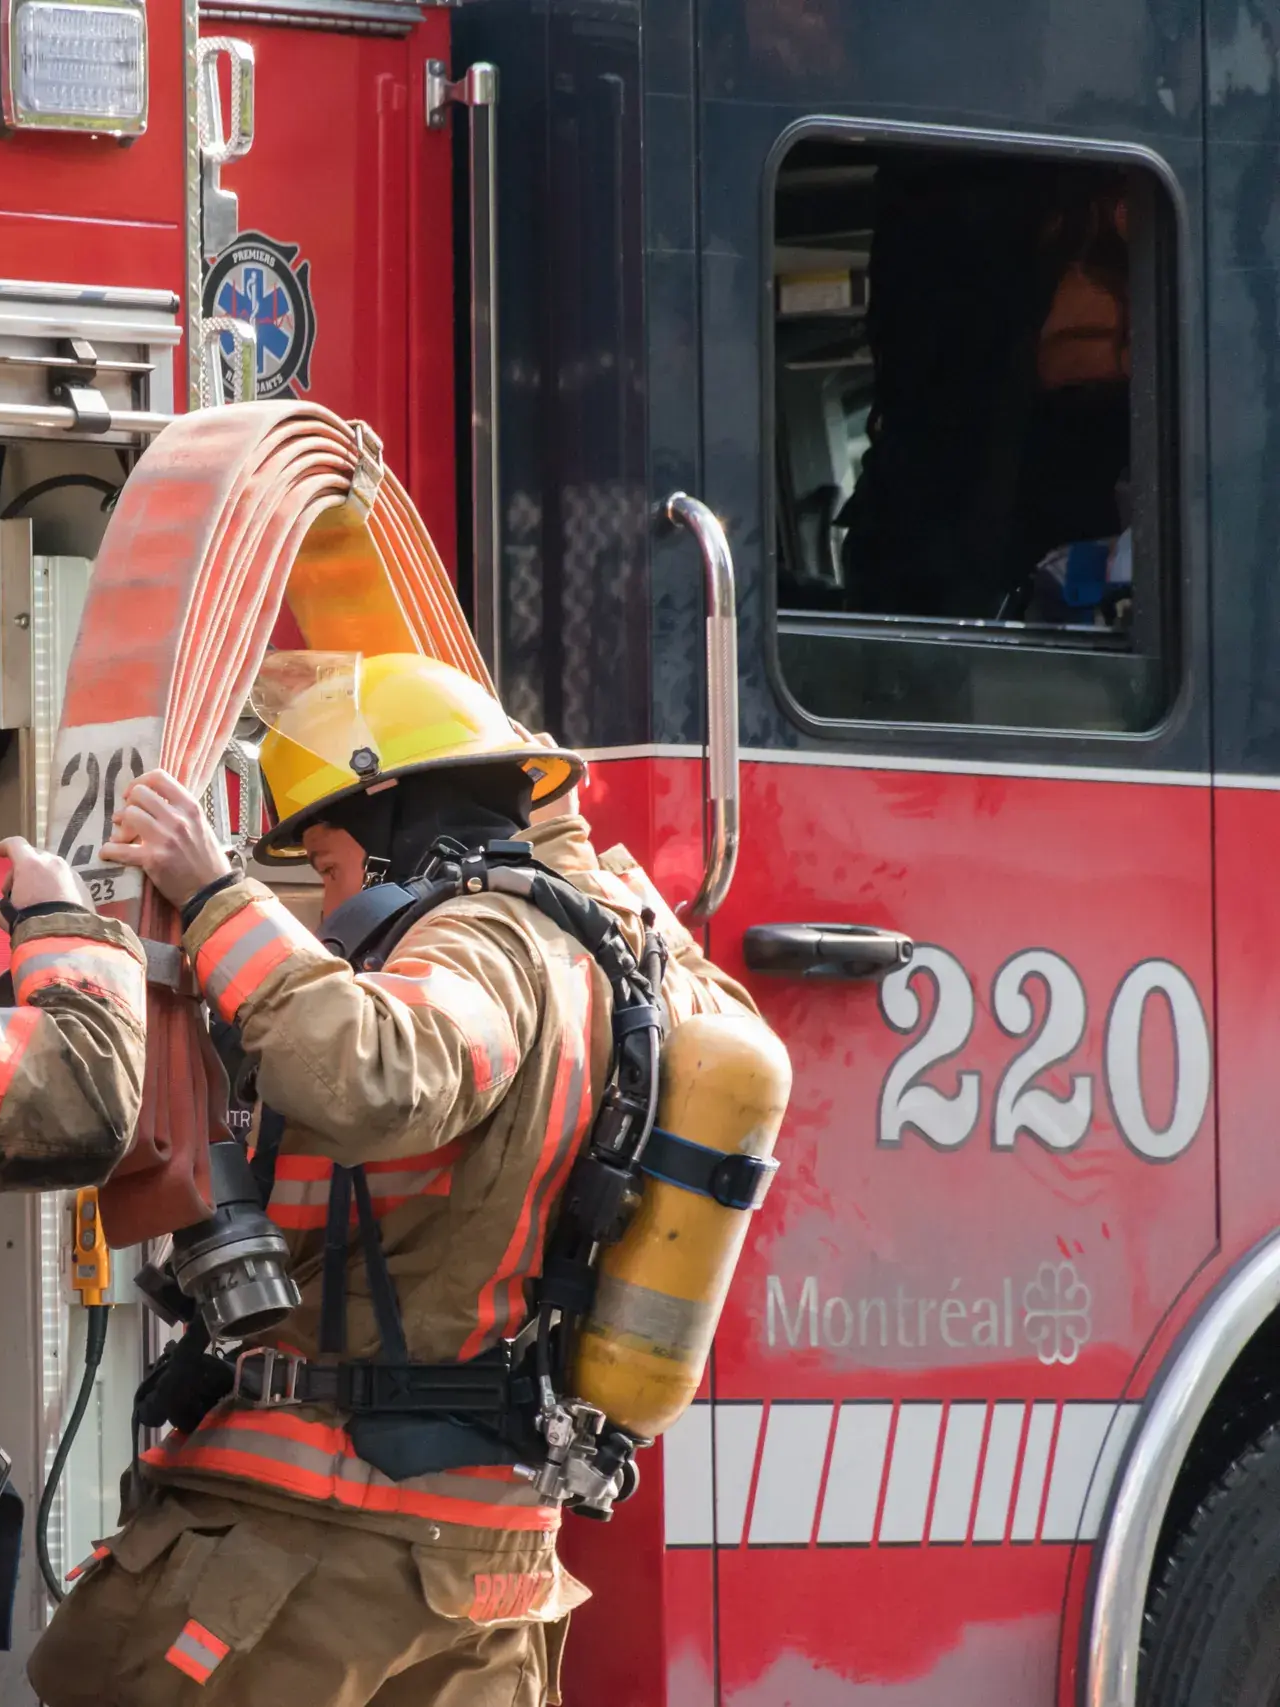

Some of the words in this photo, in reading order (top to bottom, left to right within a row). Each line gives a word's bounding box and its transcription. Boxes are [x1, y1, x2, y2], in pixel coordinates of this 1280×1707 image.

[232, 249, 276, 267] PREMIERS
[875, 941, 1211, 1166] 220
[766, 1274, 1013, 1348] Montréal
